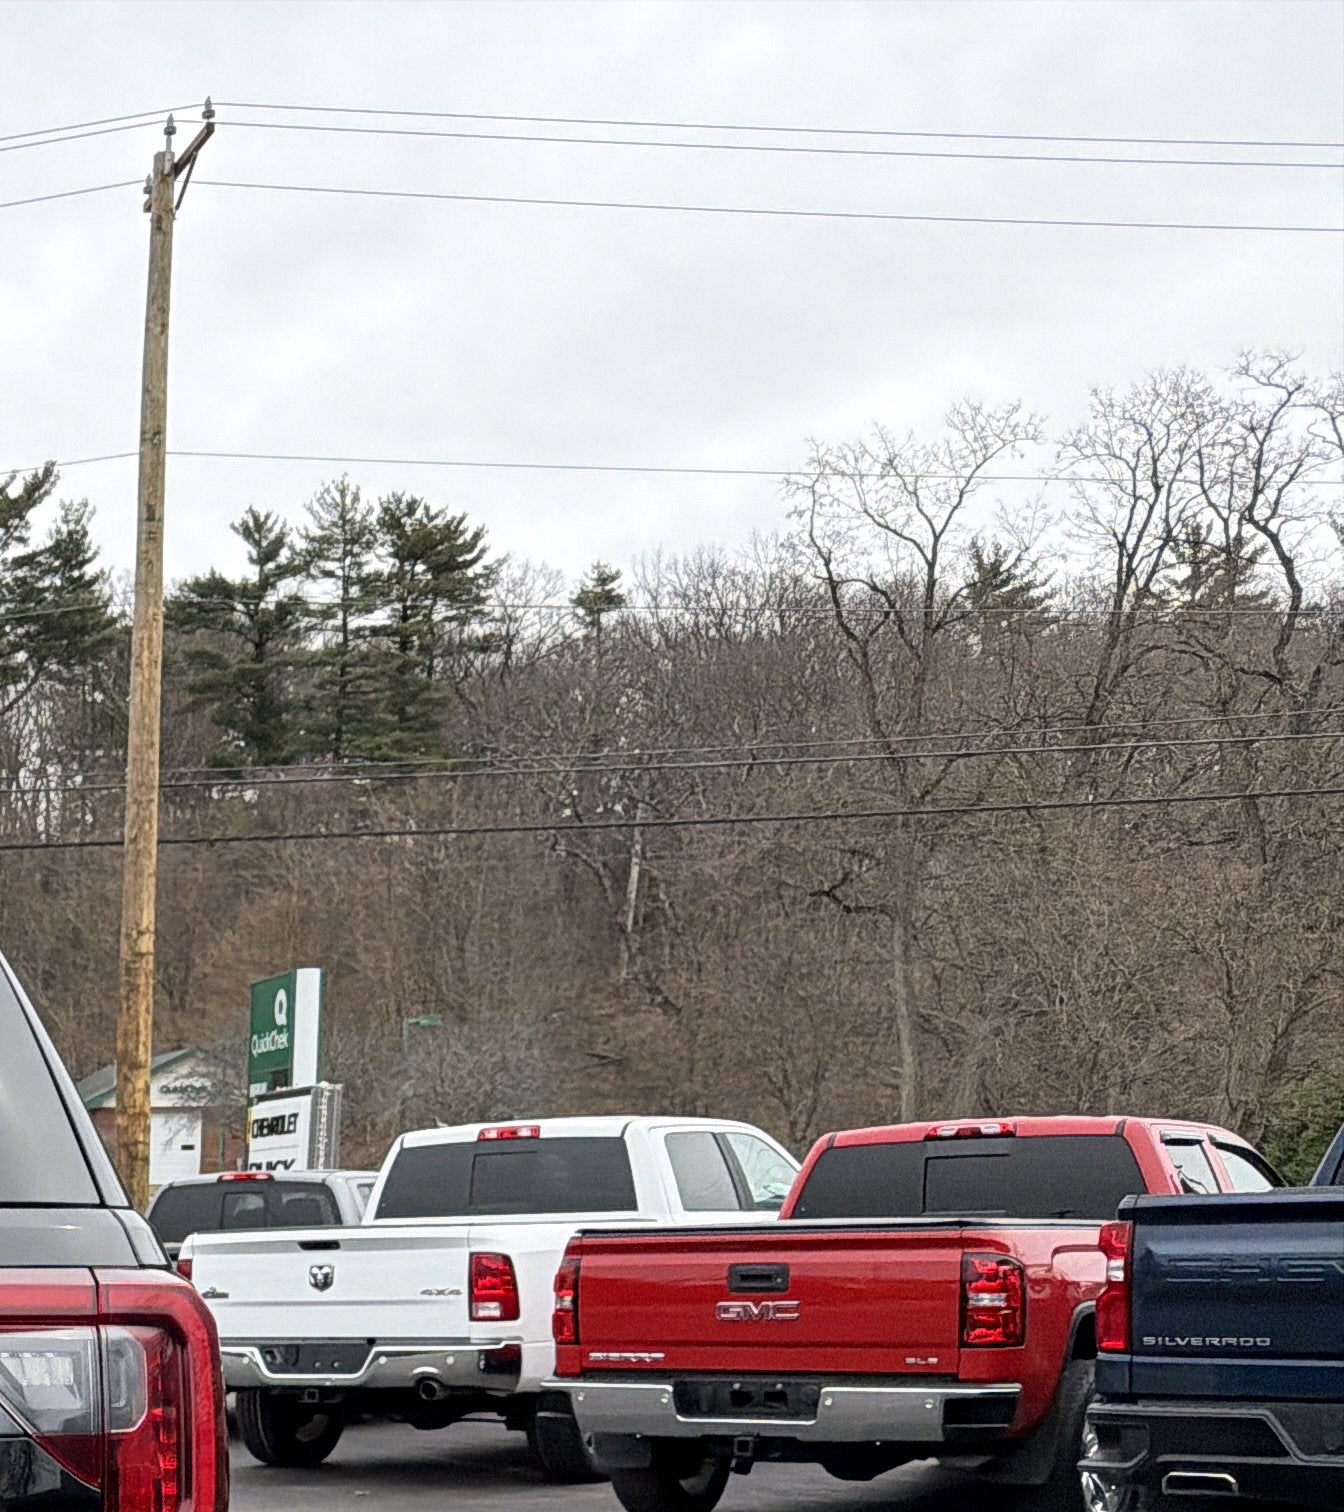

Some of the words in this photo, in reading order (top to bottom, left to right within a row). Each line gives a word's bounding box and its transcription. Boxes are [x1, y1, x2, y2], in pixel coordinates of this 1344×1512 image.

[252, 1028, 289, 1057] QuickChek
[252, 1112, 299, 1139] CHEVROLET
[716, 1301, 800, 1321] GMC
[1142, 1336, 1271, 1347] SILVERADO
